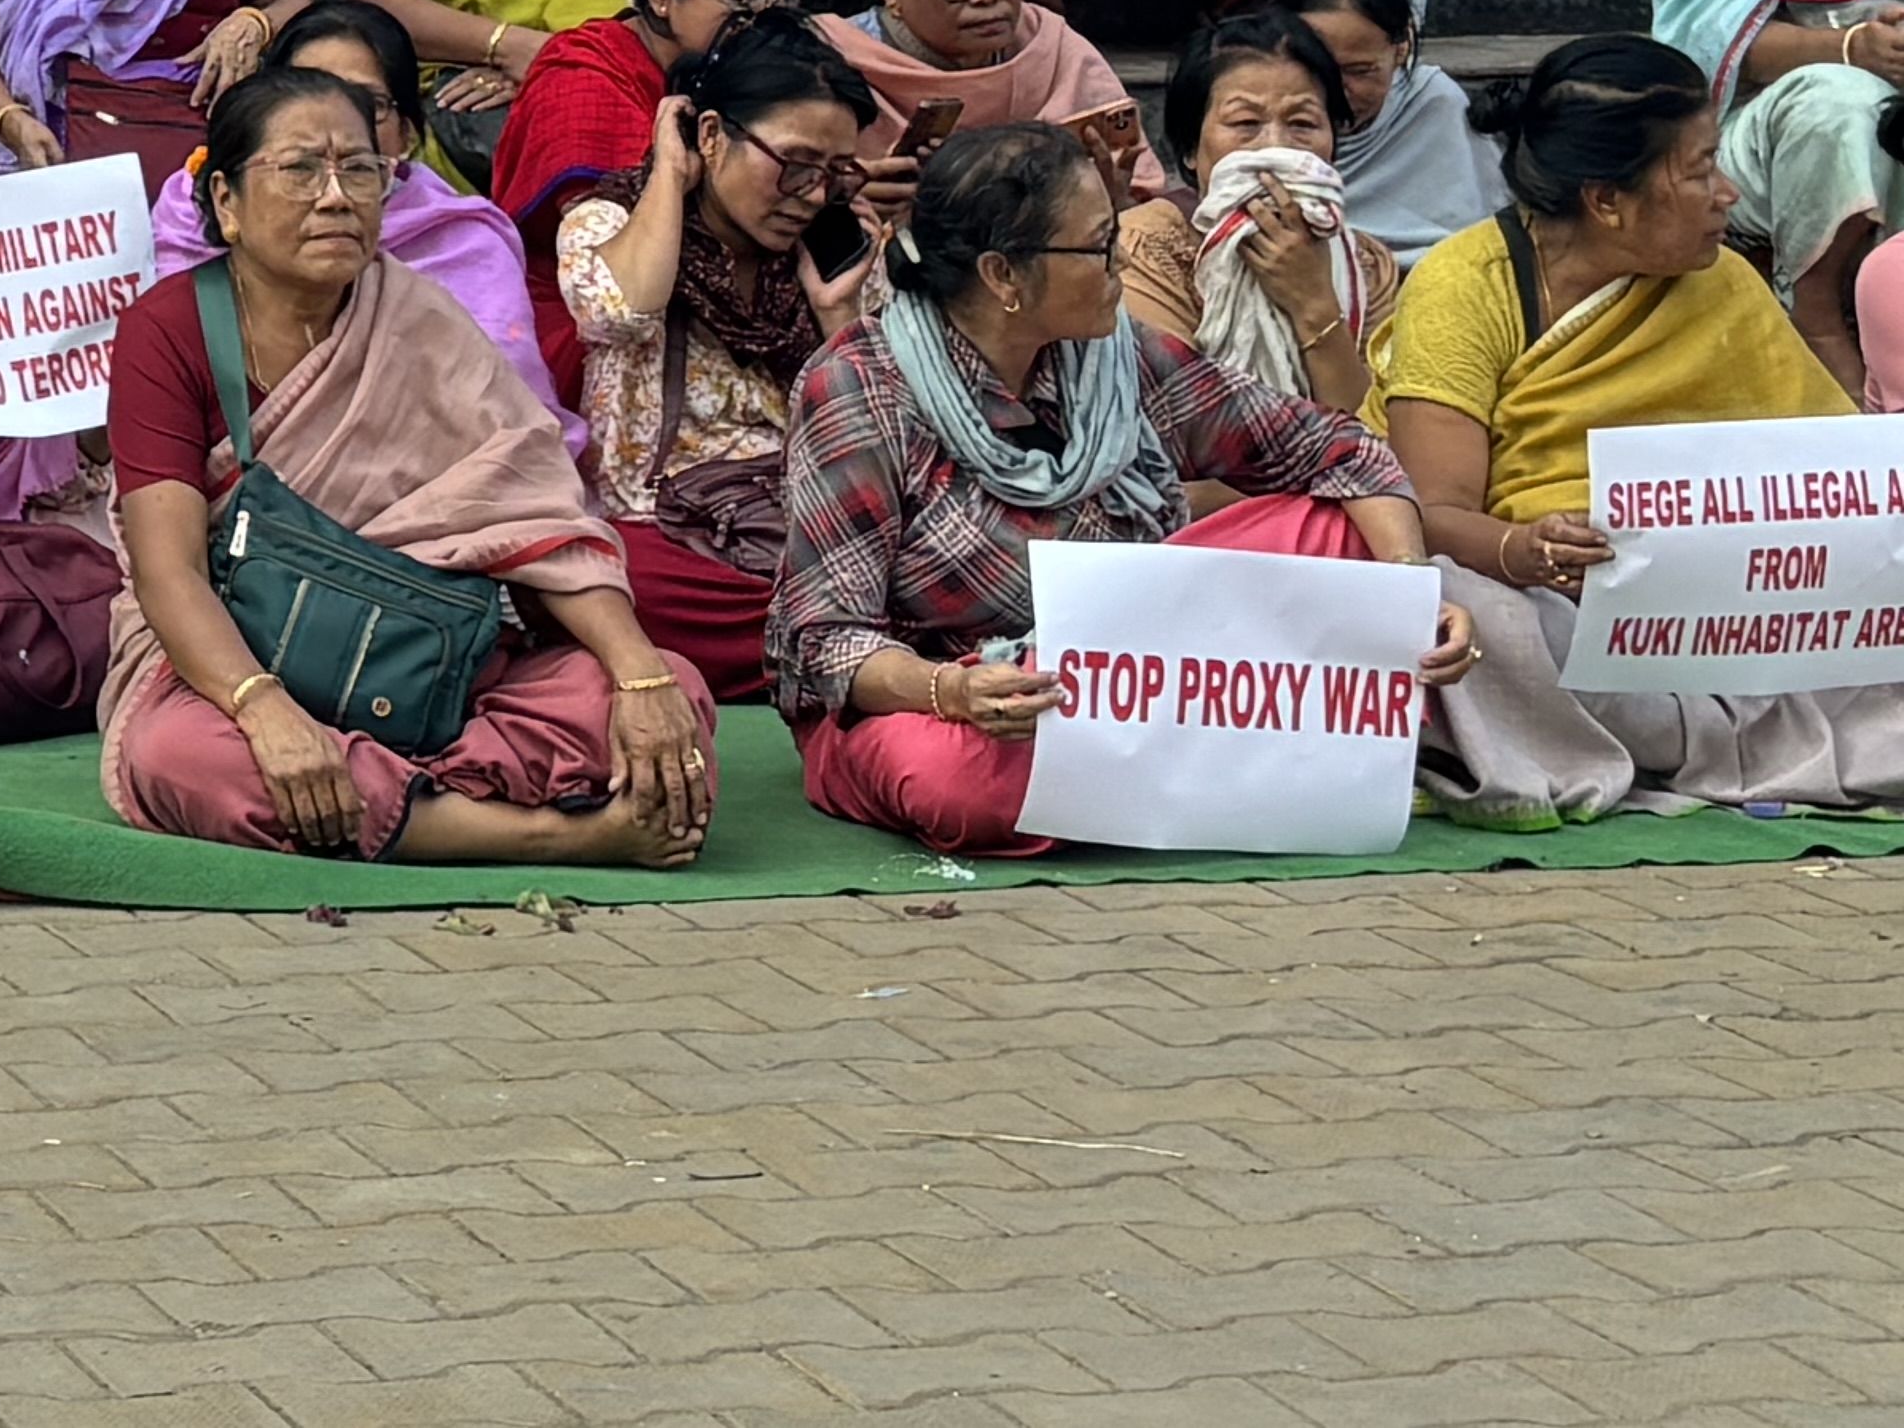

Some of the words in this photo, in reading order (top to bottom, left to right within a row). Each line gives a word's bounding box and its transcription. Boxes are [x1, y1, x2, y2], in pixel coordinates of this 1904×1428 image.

[22, 271, 142, 336] AGAINST
[1607, 479, 1693, 529] SIEGE
[1702, 475, 1754, 525] ALL
[1761, 469, 1879, 522] ILLEGAL
[1745, 545, 1828, 592] FROM
[1606, 617, 1686, 656] KUKI
[1690, 609, 1852, 656] INHABITAT
[1058, 648, 1165, 723] STOP
[1176, 657, 1312, 732] PROXY
[1323, 664, 1413, 739] WAR
